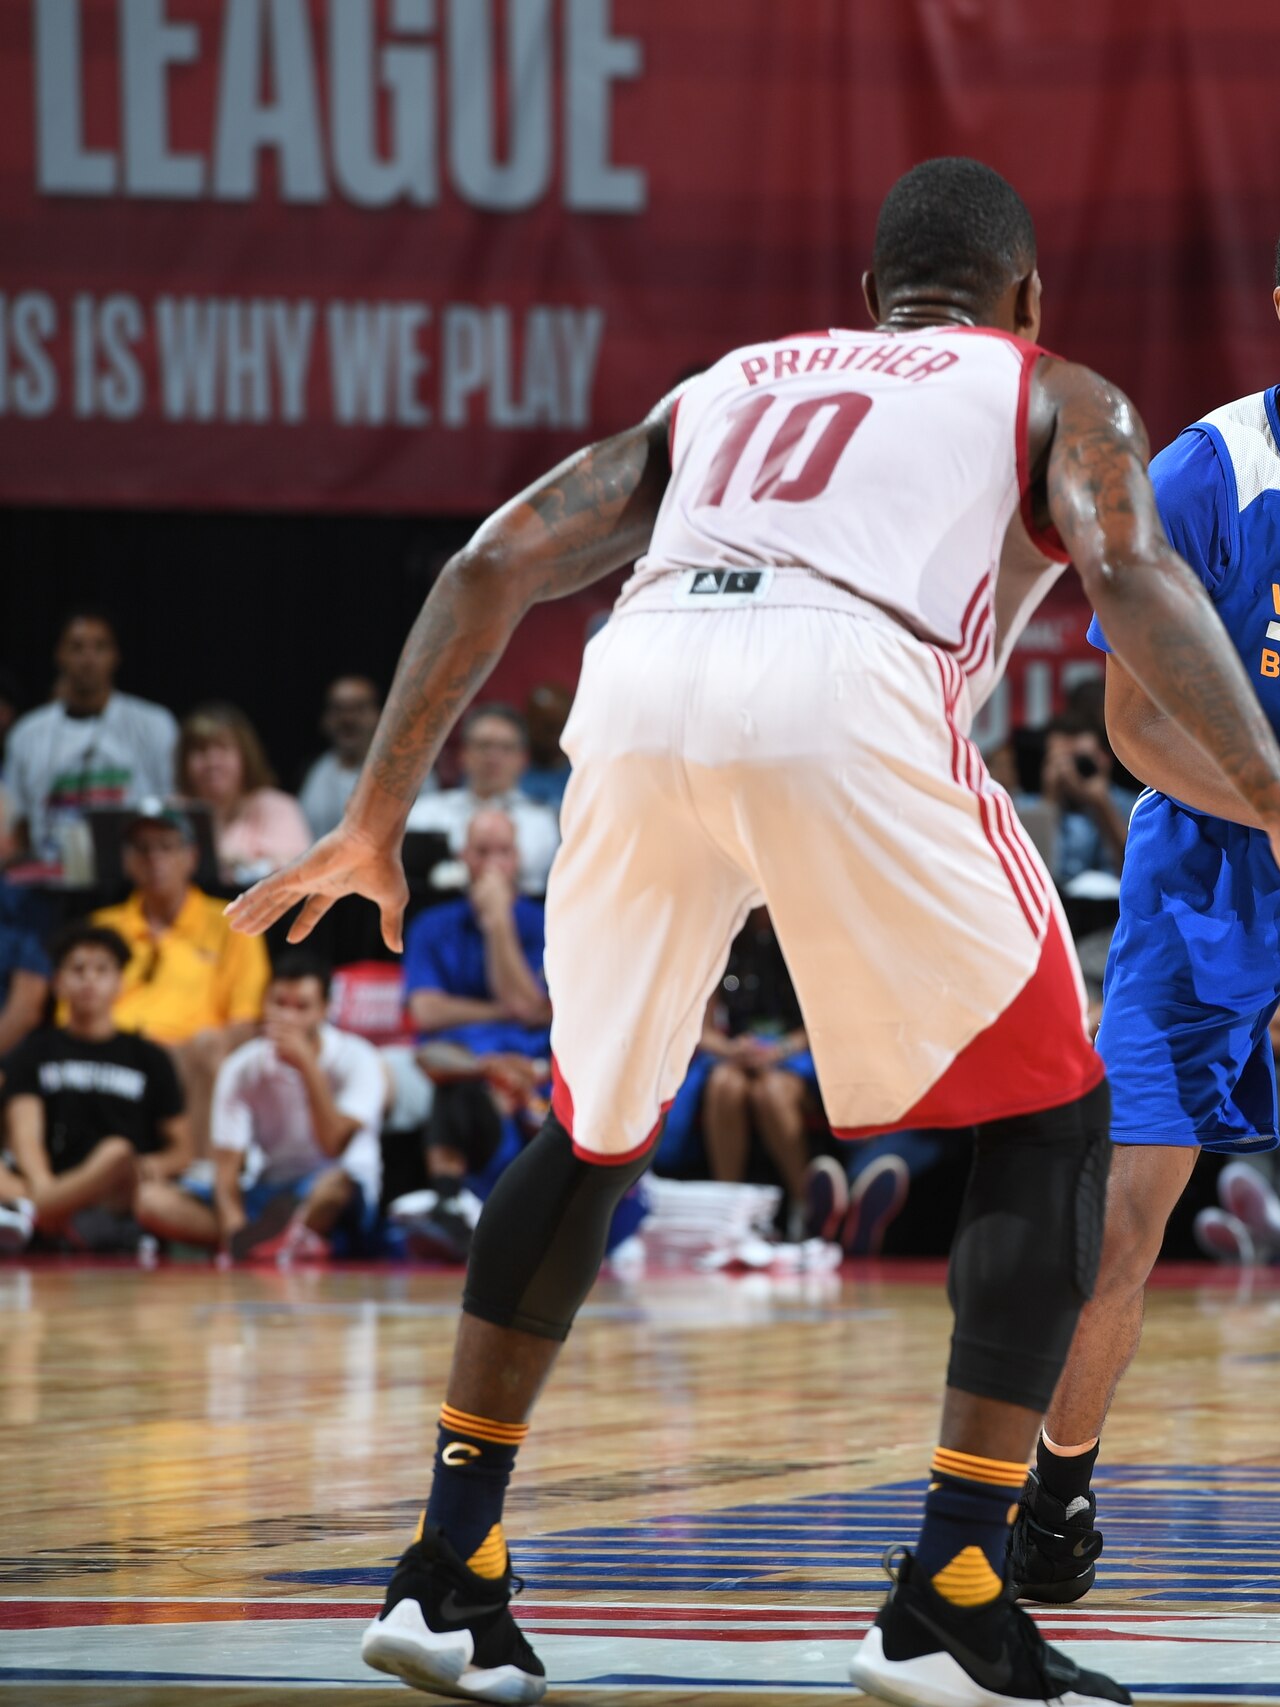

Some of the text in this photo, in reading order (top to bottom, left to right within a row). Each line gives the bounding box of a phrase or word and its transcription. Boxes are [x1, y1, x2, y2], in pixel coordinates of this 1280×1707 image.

[34, 0, 646, 213] LEAGUE
[75, 292, 144, 419] IS
[157, 297, 314, 422] WHY
[329, 303, 430, 427] WE
[443, 305, 604, 430] PLAY
[740, 345, 960, 386] PRATHER
[695, 391, 873, 509] 10
